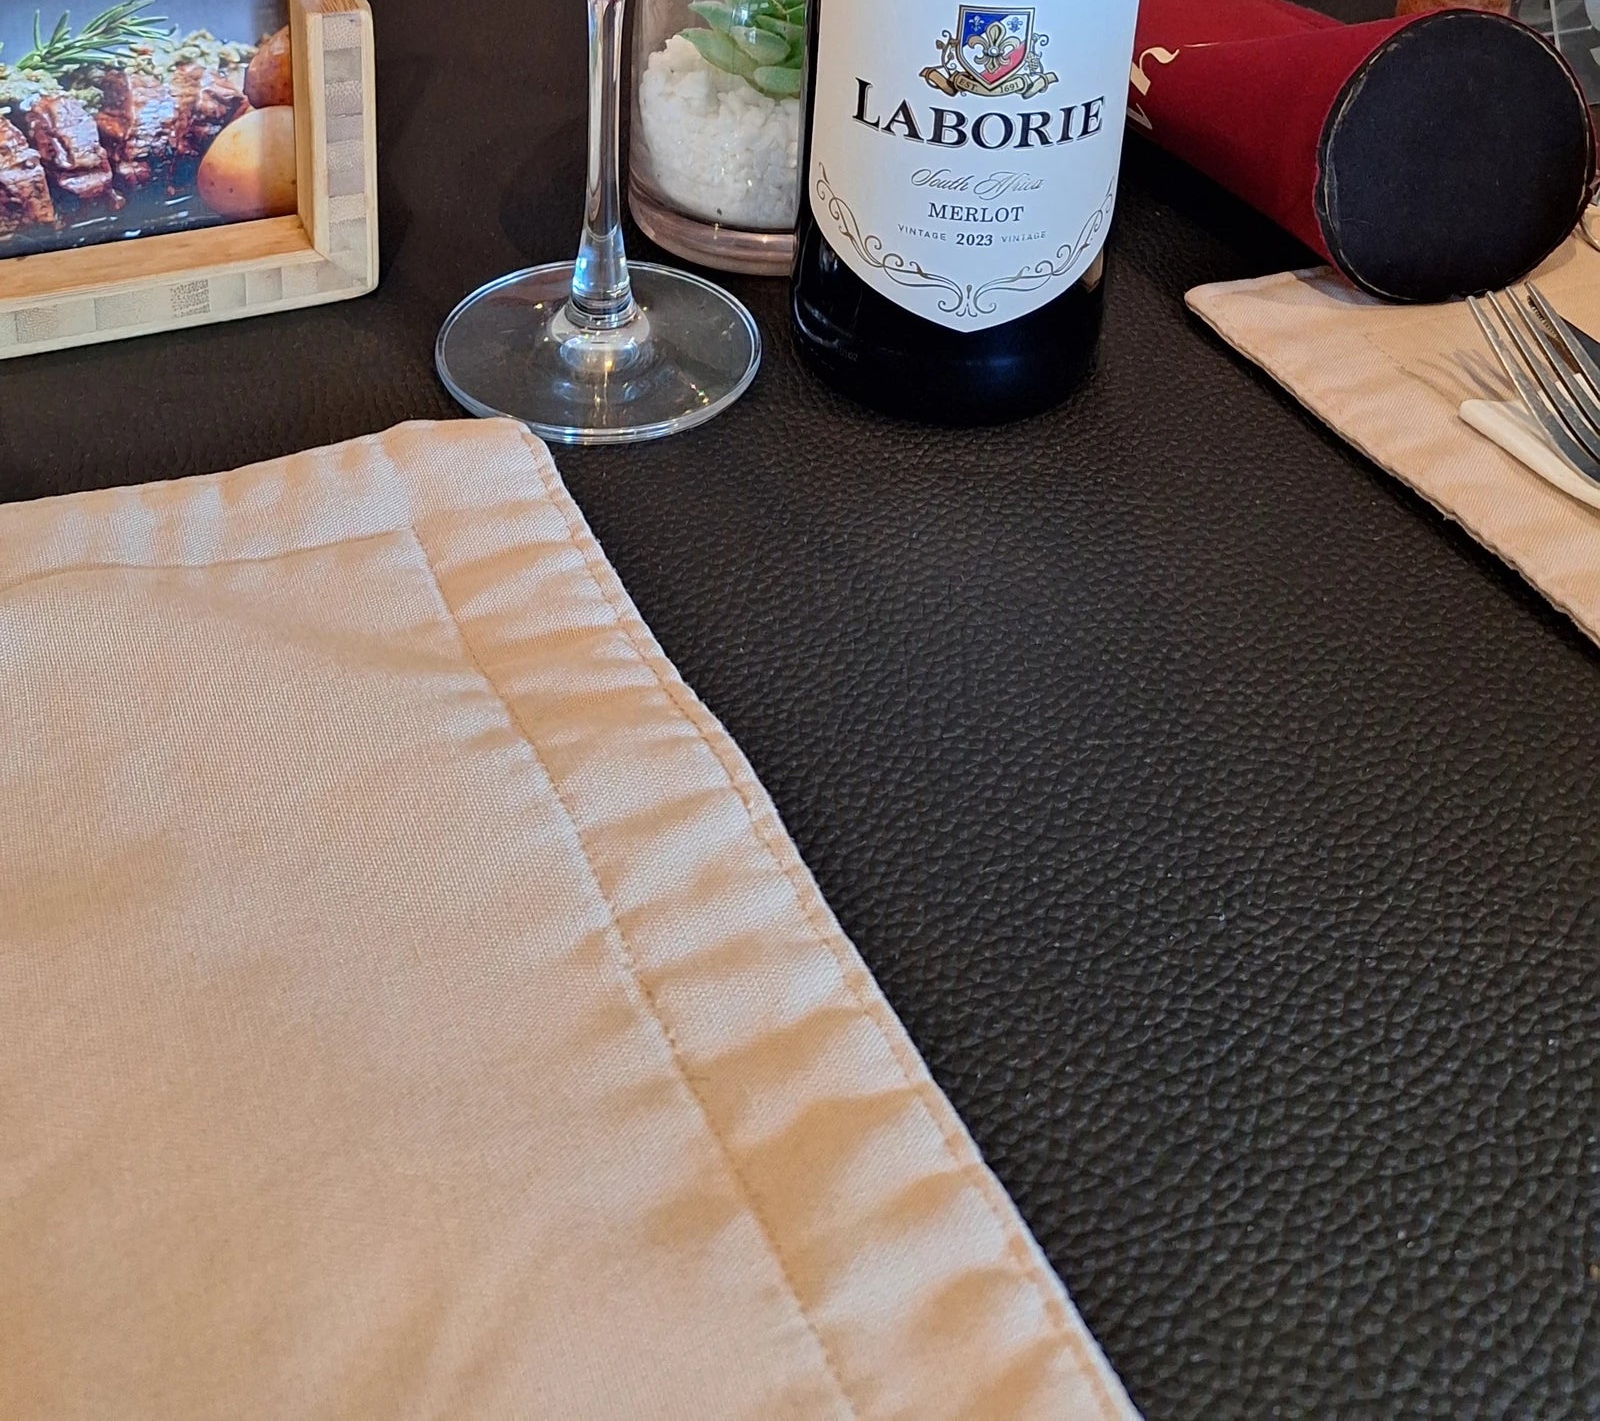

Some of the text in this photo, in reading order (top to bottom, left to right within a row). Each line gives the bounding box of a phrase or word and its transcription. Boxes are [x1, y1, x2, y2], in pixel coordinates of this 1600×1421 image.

[959, 78, 1020, 94] EST. 1691
[851, 77, 1106, 150] LABORIE
[910, 168, 975, 192] South
[928, 201, 1025, 223] MERLOT
[898, 223, 1047, 247] VINTAGE 2023 VINTAGE
